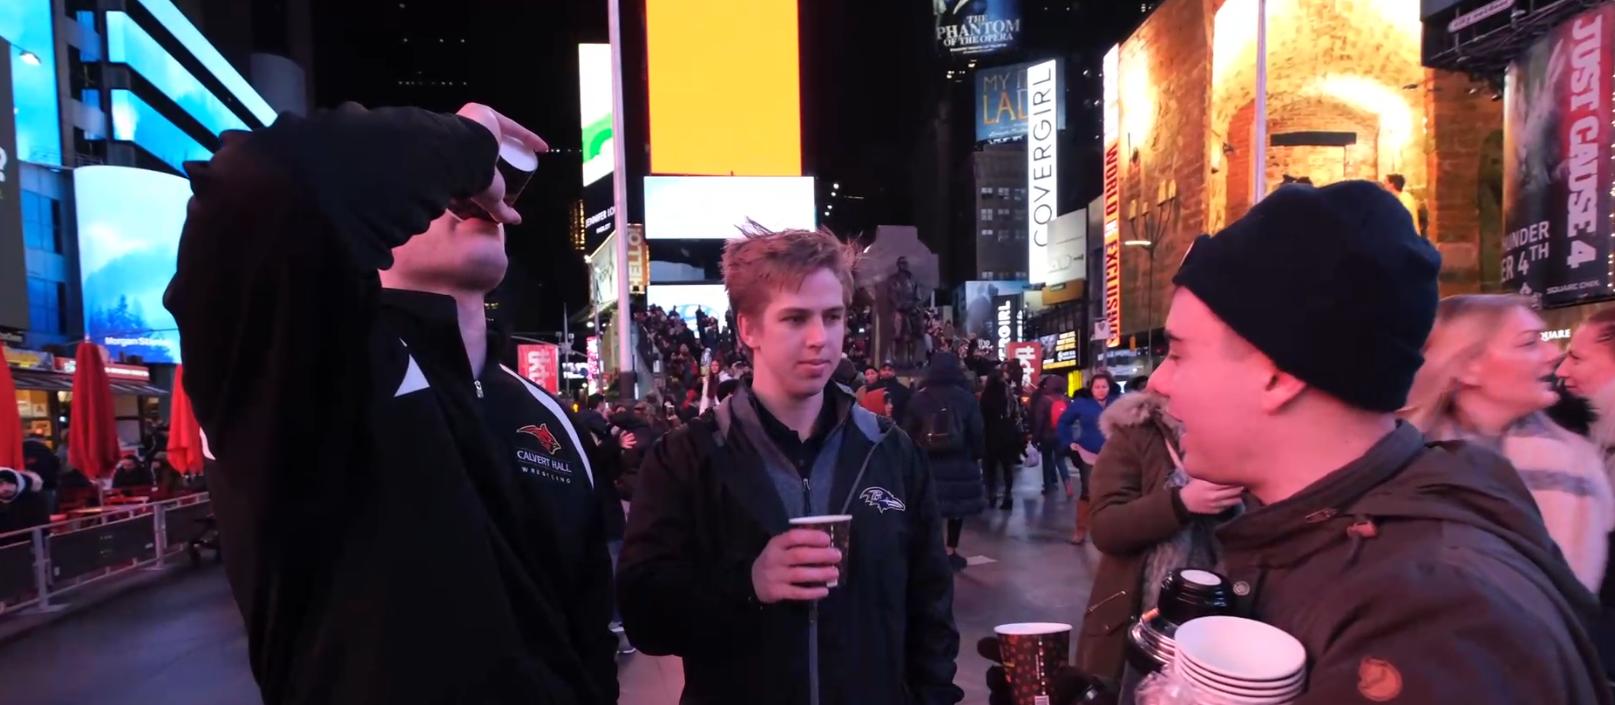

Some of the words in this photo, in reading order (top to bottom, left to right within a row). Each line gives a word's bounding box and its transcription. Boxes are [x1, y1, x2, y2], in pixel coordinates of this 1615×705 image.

[936, 19, 1020, 40] PHANTOM
[966, 15, 988, 24] THE
[943, 39, 957, 47] OF
[960, 36, 979, 45] THE
[980, 32, 1014, 43] OPERA
[1570, 15, 1603, 112] JUST
[983, 72, 1010, 92] MY
[1032, 67, 1053, 248] COVERGIRL
[1567, 115, 1600, 238] CAUSE
[1517, 242, 1550, 276] 4TH
[1566, 240, 1597, 269] 4
[1546, 283, 1578, 295] SQUARE
[105, 336, 138, 347] Morgan
[516, 450, 551, 466] CALVERT
[552, 460, 572, 472] HALL
